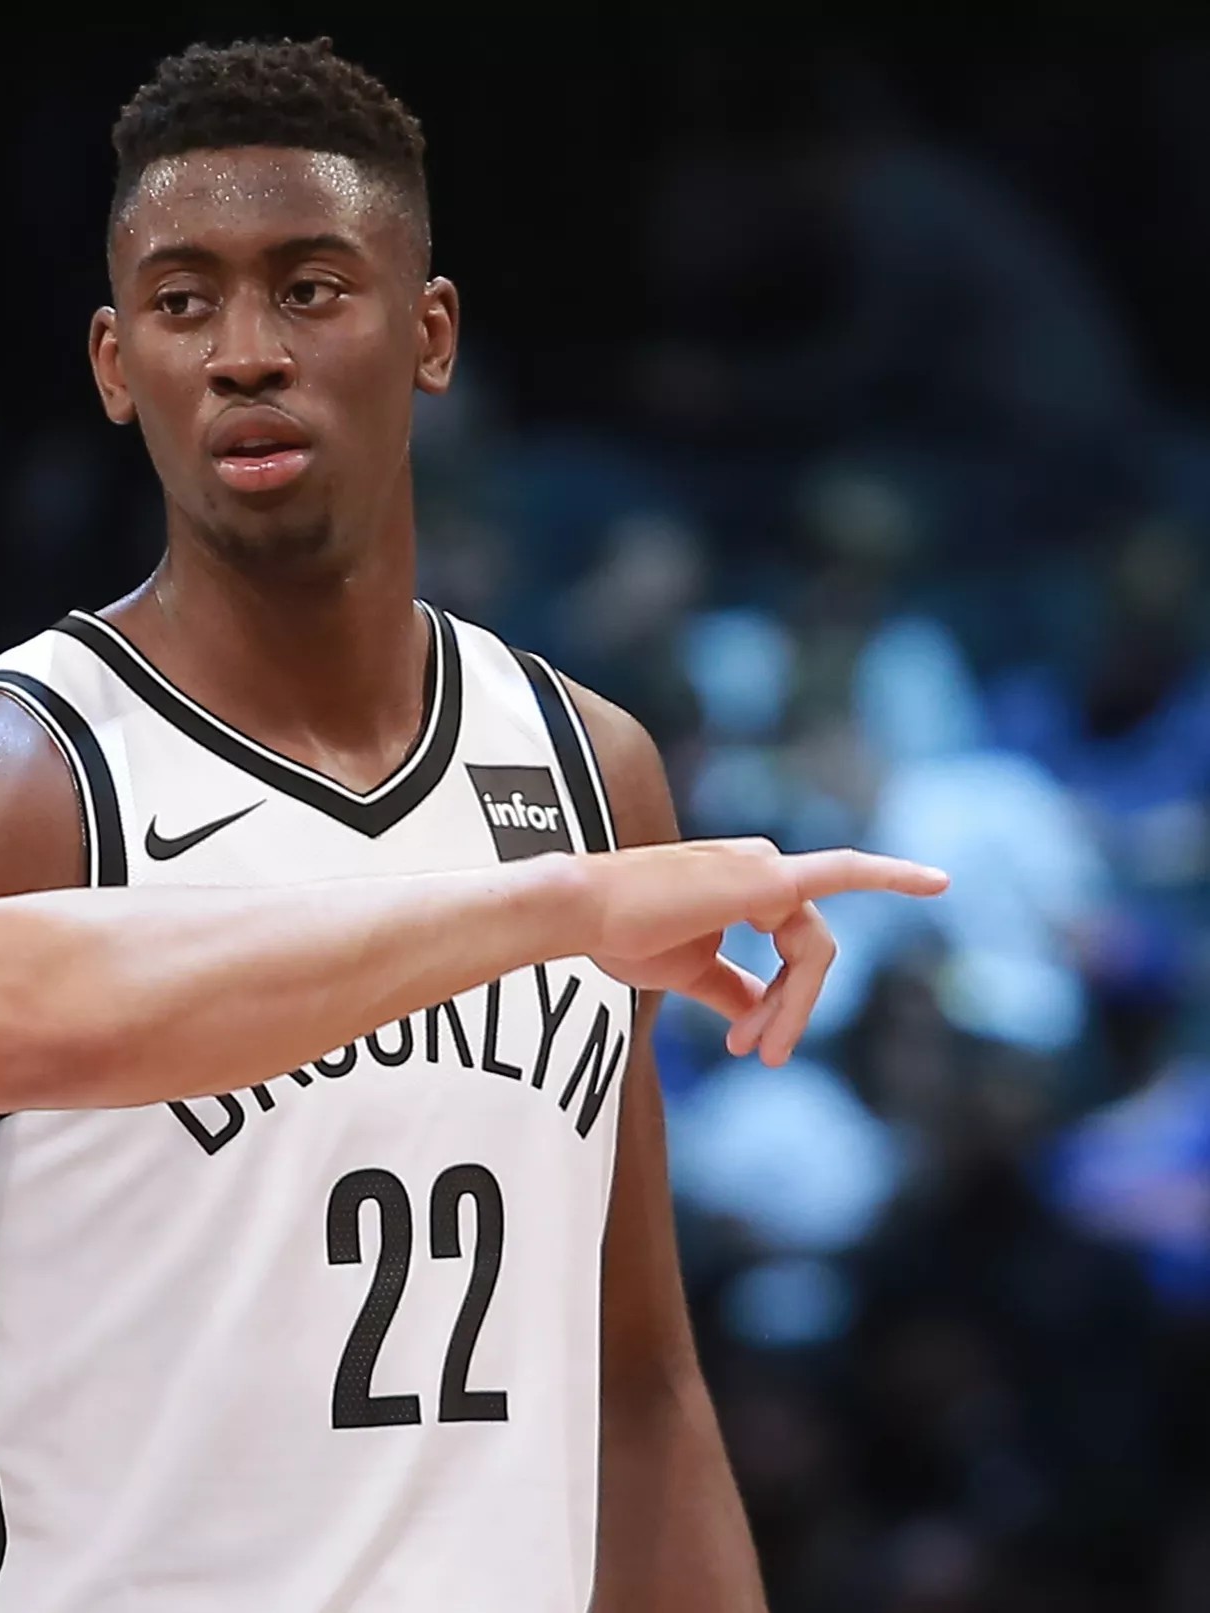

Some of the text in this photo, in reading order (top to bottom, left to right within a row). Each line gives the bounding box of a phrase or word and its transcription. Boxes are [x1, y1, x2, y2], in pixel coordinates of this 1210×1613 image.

[483, 792, 559, 831] infor
[167, 963, 624, 1156] BKLYN
[326, 1163, 508, 1429] 22
